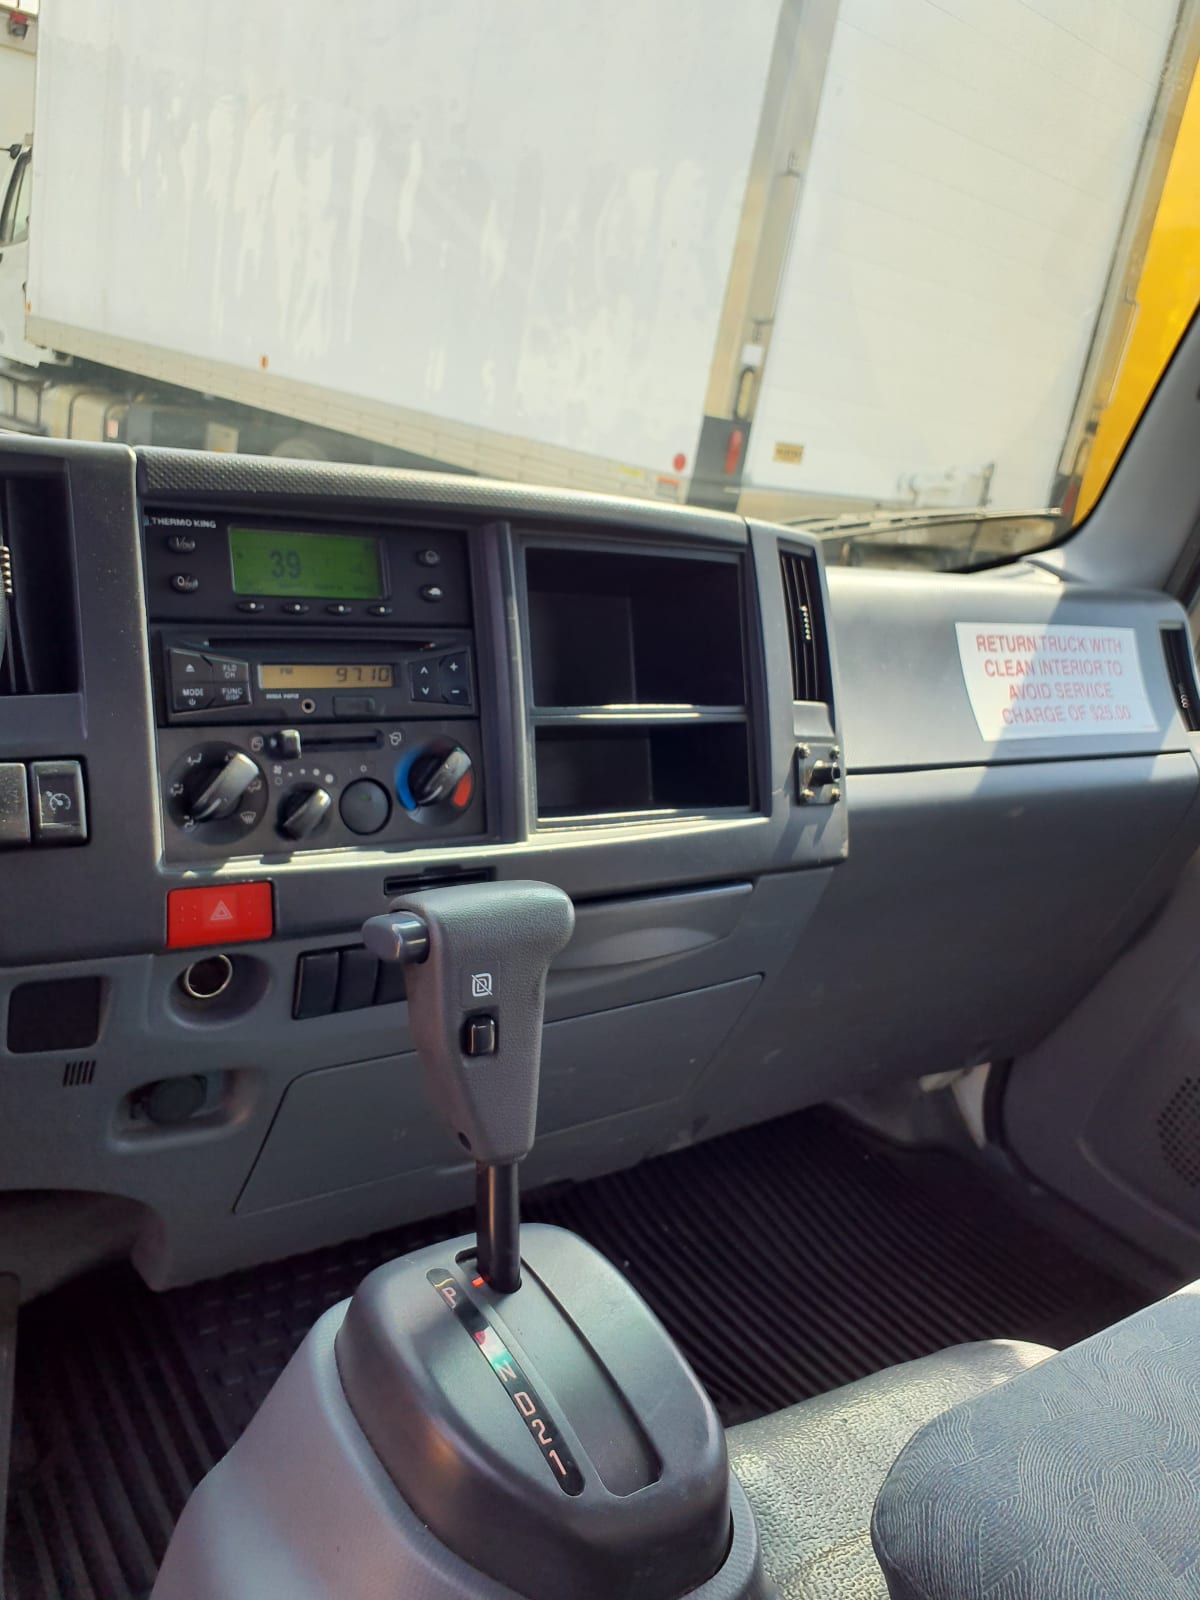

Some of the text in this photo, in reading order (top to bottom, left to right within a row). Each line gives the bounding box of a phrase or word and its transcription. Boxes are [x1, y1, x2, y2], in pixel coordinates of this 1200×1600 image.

[152, 517, 217, 529] THERMO KING
[270, 550, 302, 579] 39
[976, 634, 1121, 653] RETURN TRUCK WITH
[984, 659, 1123, 677] CLEAN INTERIOR TO
[182, 687, 204, 697] MODE
[222, 687, 243, 696] FUNC
[1009, 682, 1113, 700] AVOID SERVICE
[1002, 704, 1131, 725] CHARGE OF $25.00
[513, 1391, 536, 1417] D
[531, 1418, 553, 1445] 2
[549, 1449, 568, 1476] 1
